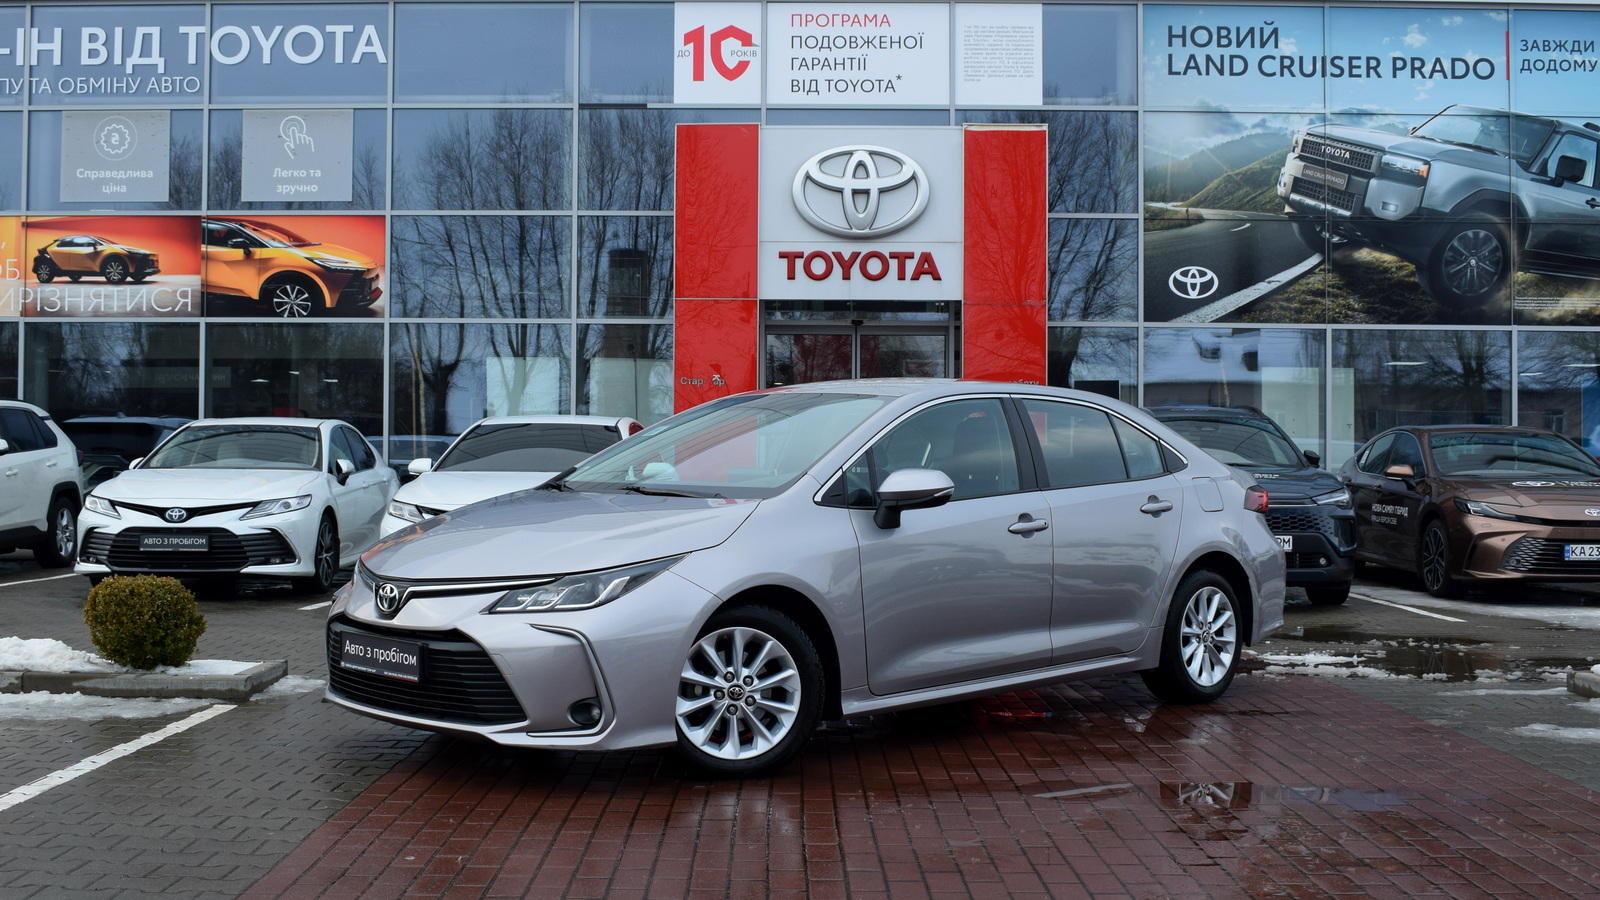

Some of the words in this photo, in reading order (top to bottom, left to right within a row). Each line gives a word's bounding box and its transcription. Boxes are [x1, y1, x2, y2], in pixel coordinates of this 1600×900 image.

[791, 13, 891, 28] ПРОГРАМА
[791, 32, 925, 52] ПОДОВЖЕНОЇ
[1167, 20, 1279, 49] НОВИЙ
[80, 26, 165, 74] ВІД
[179, 24, 388, 65] TOYOTA
[677, 49, 691, 59] ДО
[730, 49, 758, 58] РОКІВ
[1520, 39, 1595, 55] ЗАВЖДИ
[791, 53, 868, 71] ГАРАНТІЇ
[1167, 53, 1249, 77] LAND
[1257, 54, 1383, 79] CRUISER
[1391, 56, 1496, 81] PRADO
[1520, 58, 1599, 75] ДОДОМУ
[30, 77, 52, 94] ТА
[58, 76, 142, 95] ОБМІНУ
[146, 75, 201, 94] АВТО
[791, 79, 820, 96] ВІД
[1321, 145, 1350, 159] TOYOTA
[76, 168, 154, 180] Справедлива
[272, 168, 307, 178] Легко
[309, 169, 322, 177] та
[102, 182, 127, 194] ціна
[276, 184, 319, 195] зручно
[0, 258, 20, 281] Б
[778, 250, 943, 282] TOYOTA
[143, 537, 162, 545] АВТО
[163, 537, 168, 545] З
[169, 537, 206, 545] ПРОБІГОМ
[1570, 546, 1586, 557] KA
[344, 639, 365, 656] Авто
[366, 647, 372, 658] з
[373, 647, 417, 666] пробігом
